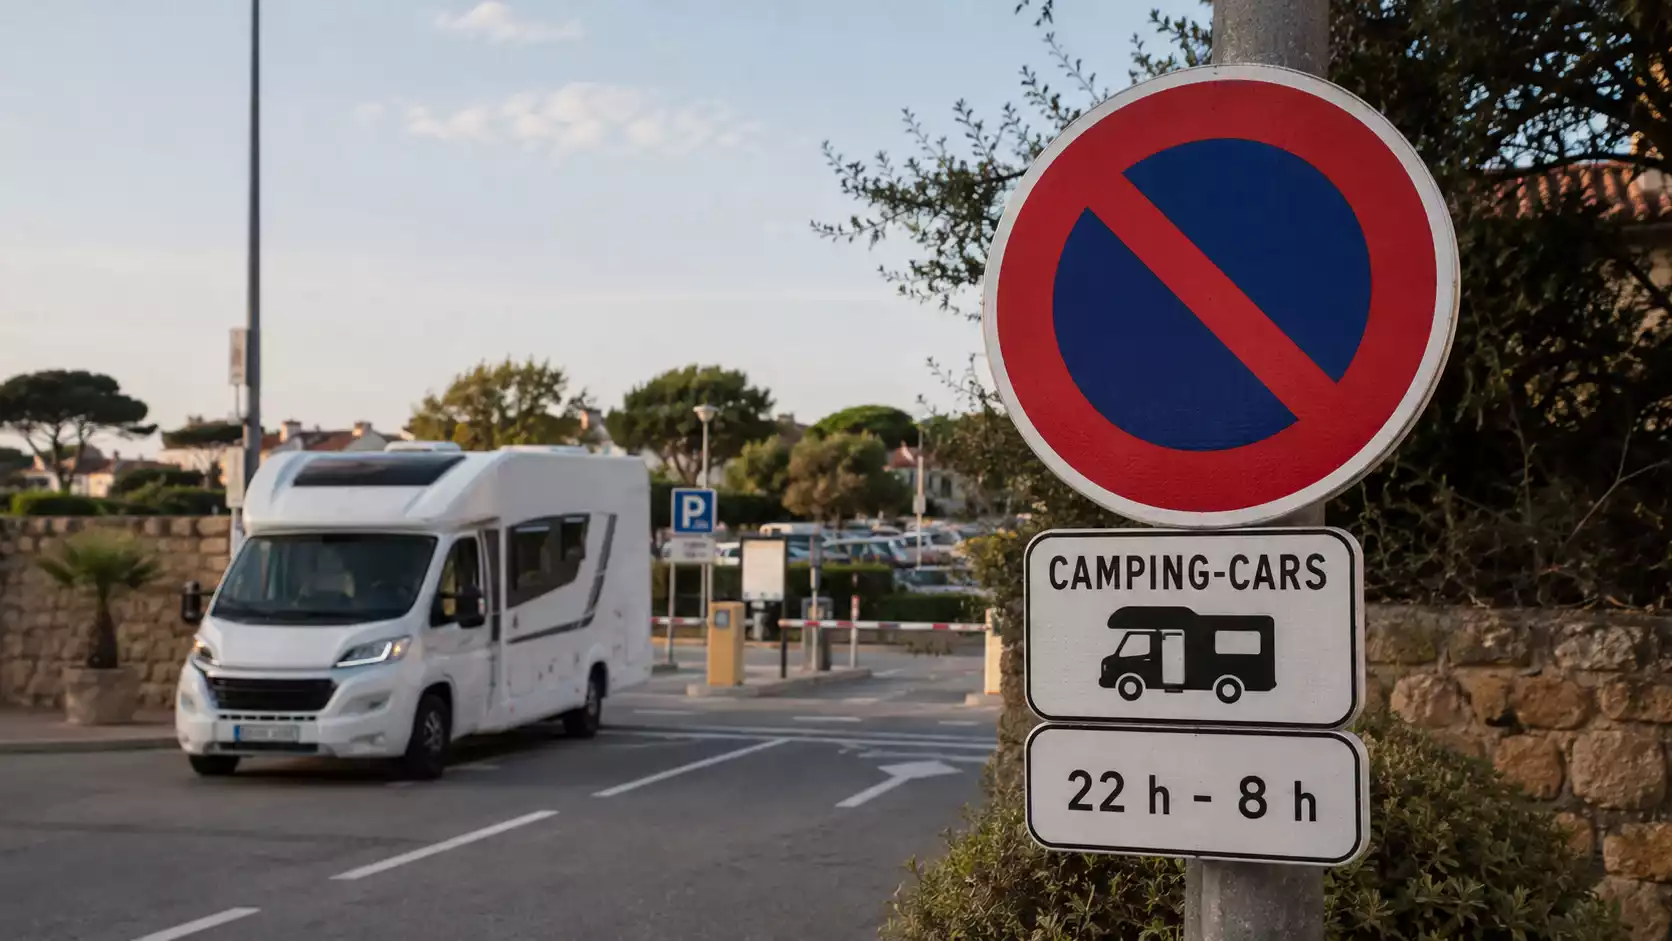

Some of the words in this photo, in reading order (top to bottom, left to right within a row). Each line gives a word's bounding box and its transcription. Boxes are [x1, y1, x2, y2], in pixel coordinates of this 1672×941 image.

[682, 495, 706, 528] P
[1050, 553, 1327, 590] CAMPING-CARS
[1068, 769, 1125, 812] 22
[1149, 774, 1170, 814] h
[1238, 776, 1267, 819] 8
[1294, 780, 1317, 821] h
